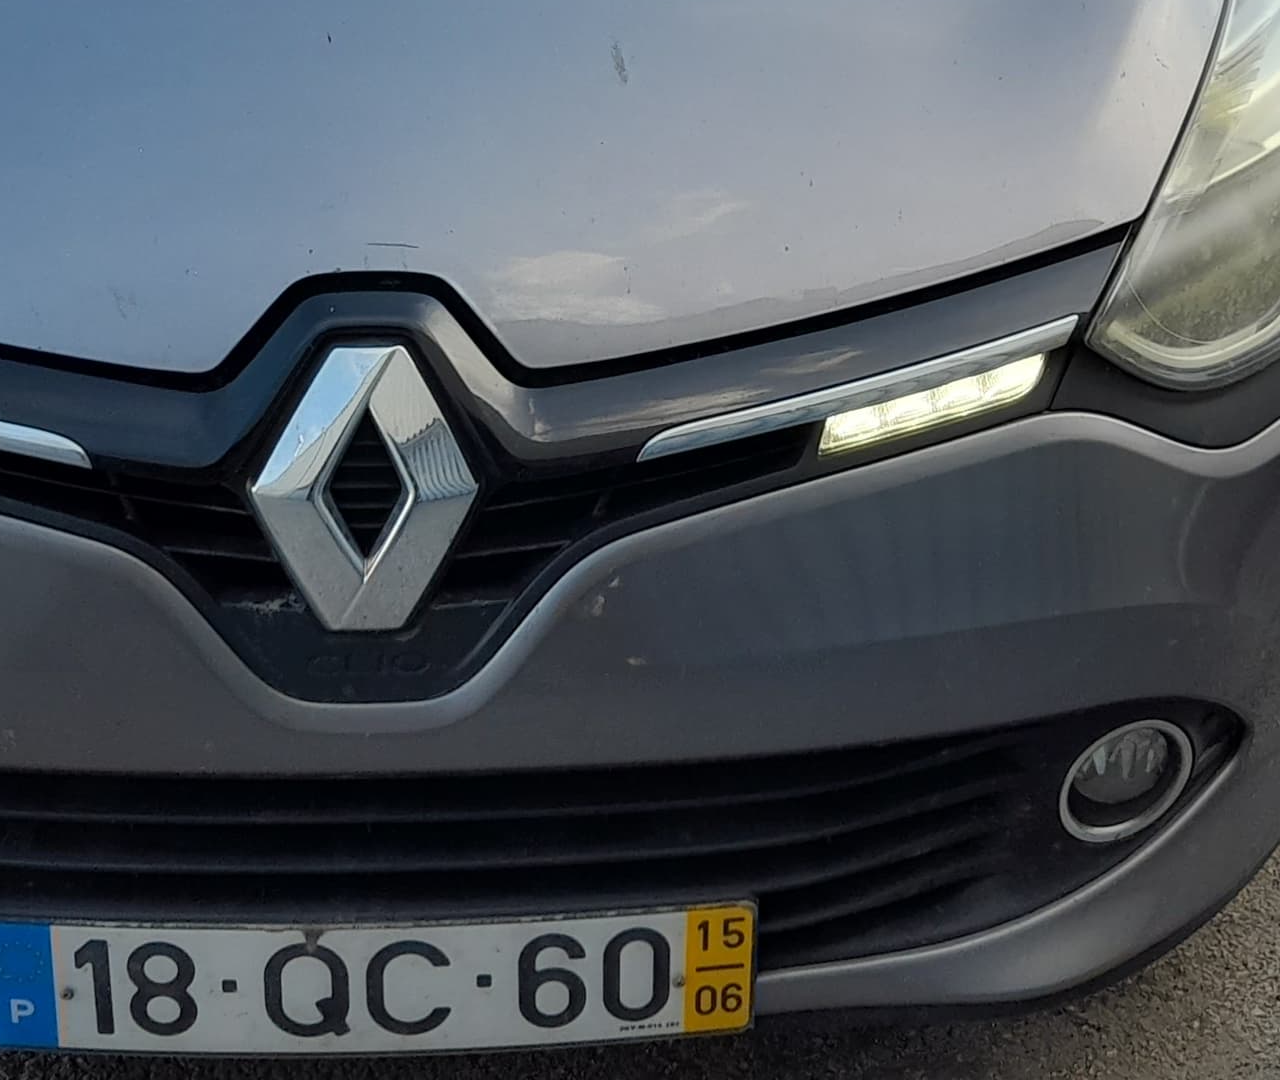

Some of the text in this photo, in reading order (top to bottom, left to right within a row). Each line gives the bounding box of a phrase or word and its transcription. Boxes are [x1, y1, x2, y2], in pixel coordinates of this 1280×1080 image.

[697, 917, 746, 952] 15
[10, 998, 35, 1024] P
[694, 983, 743, 1016] 06
